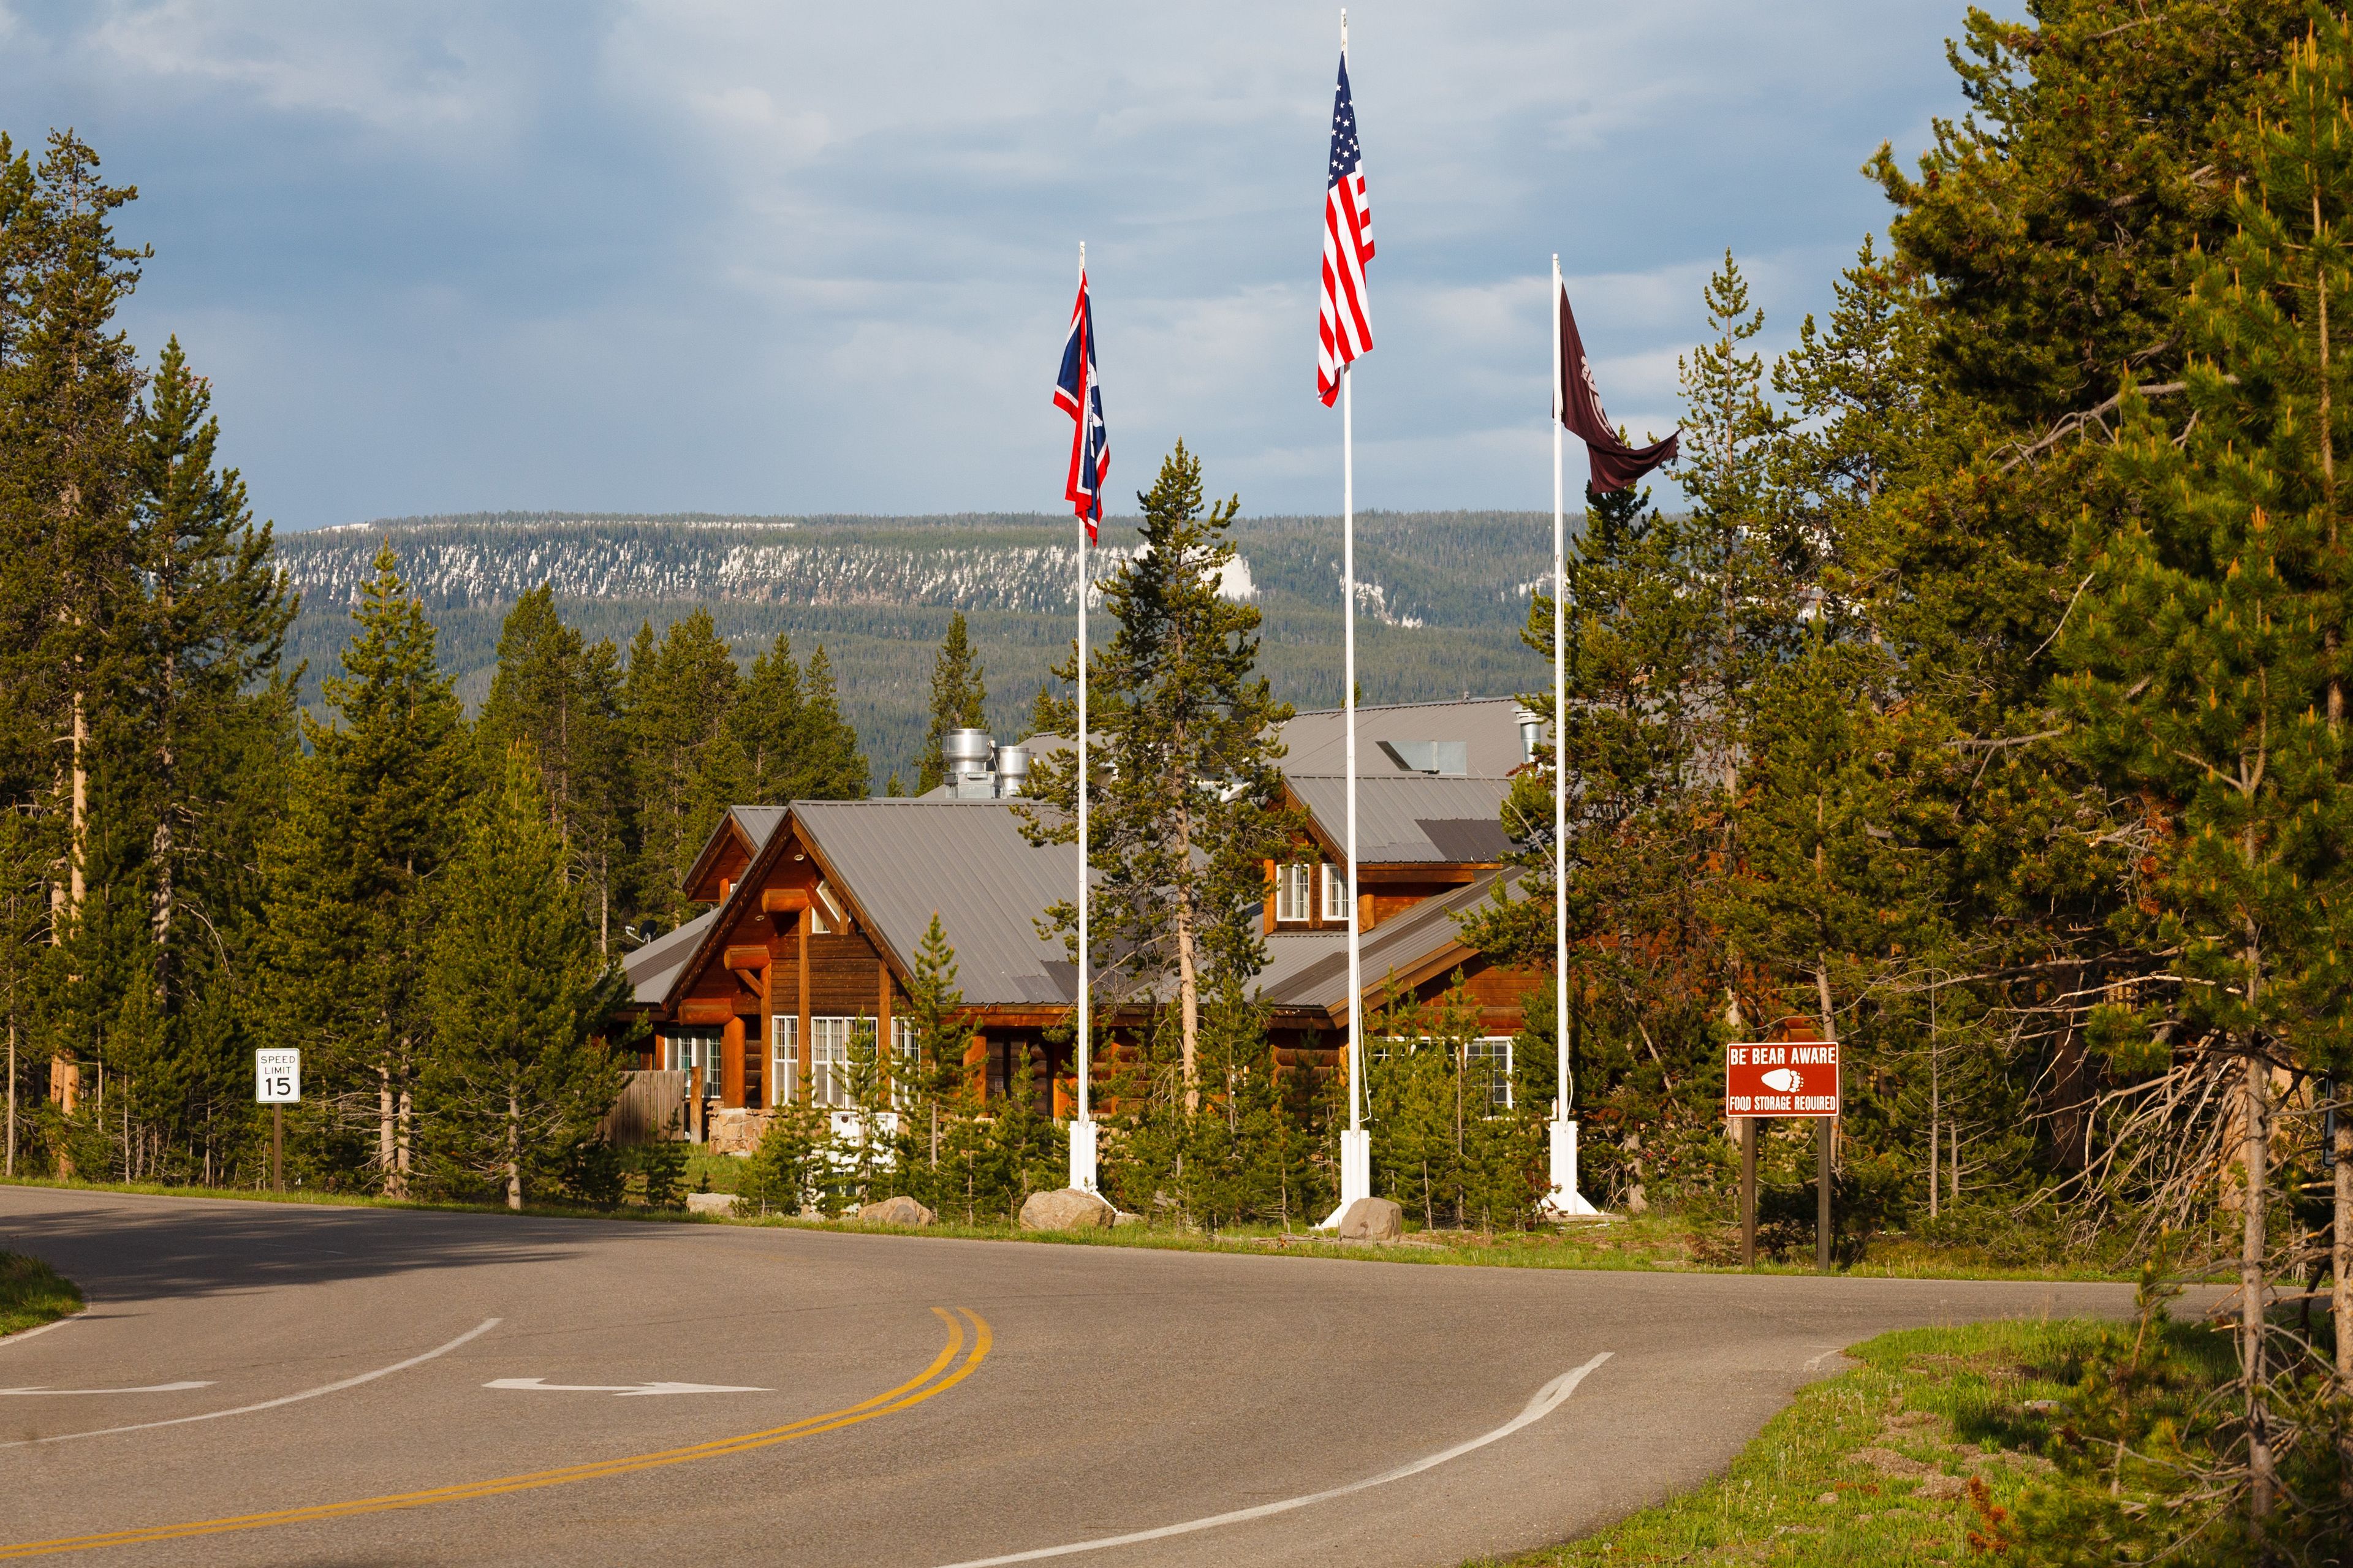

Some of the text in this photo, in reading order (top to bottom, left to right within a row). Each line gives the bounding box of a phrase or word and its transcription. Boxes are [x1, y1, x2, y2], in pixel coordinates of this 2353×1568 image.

[1730, 1047, 1836, 1065] BE BEAR AWARE
[265, 1078, 291, 1096] 15
[1730, 1096, 1835, 1111] FOOD STORAGE REQUIRED
